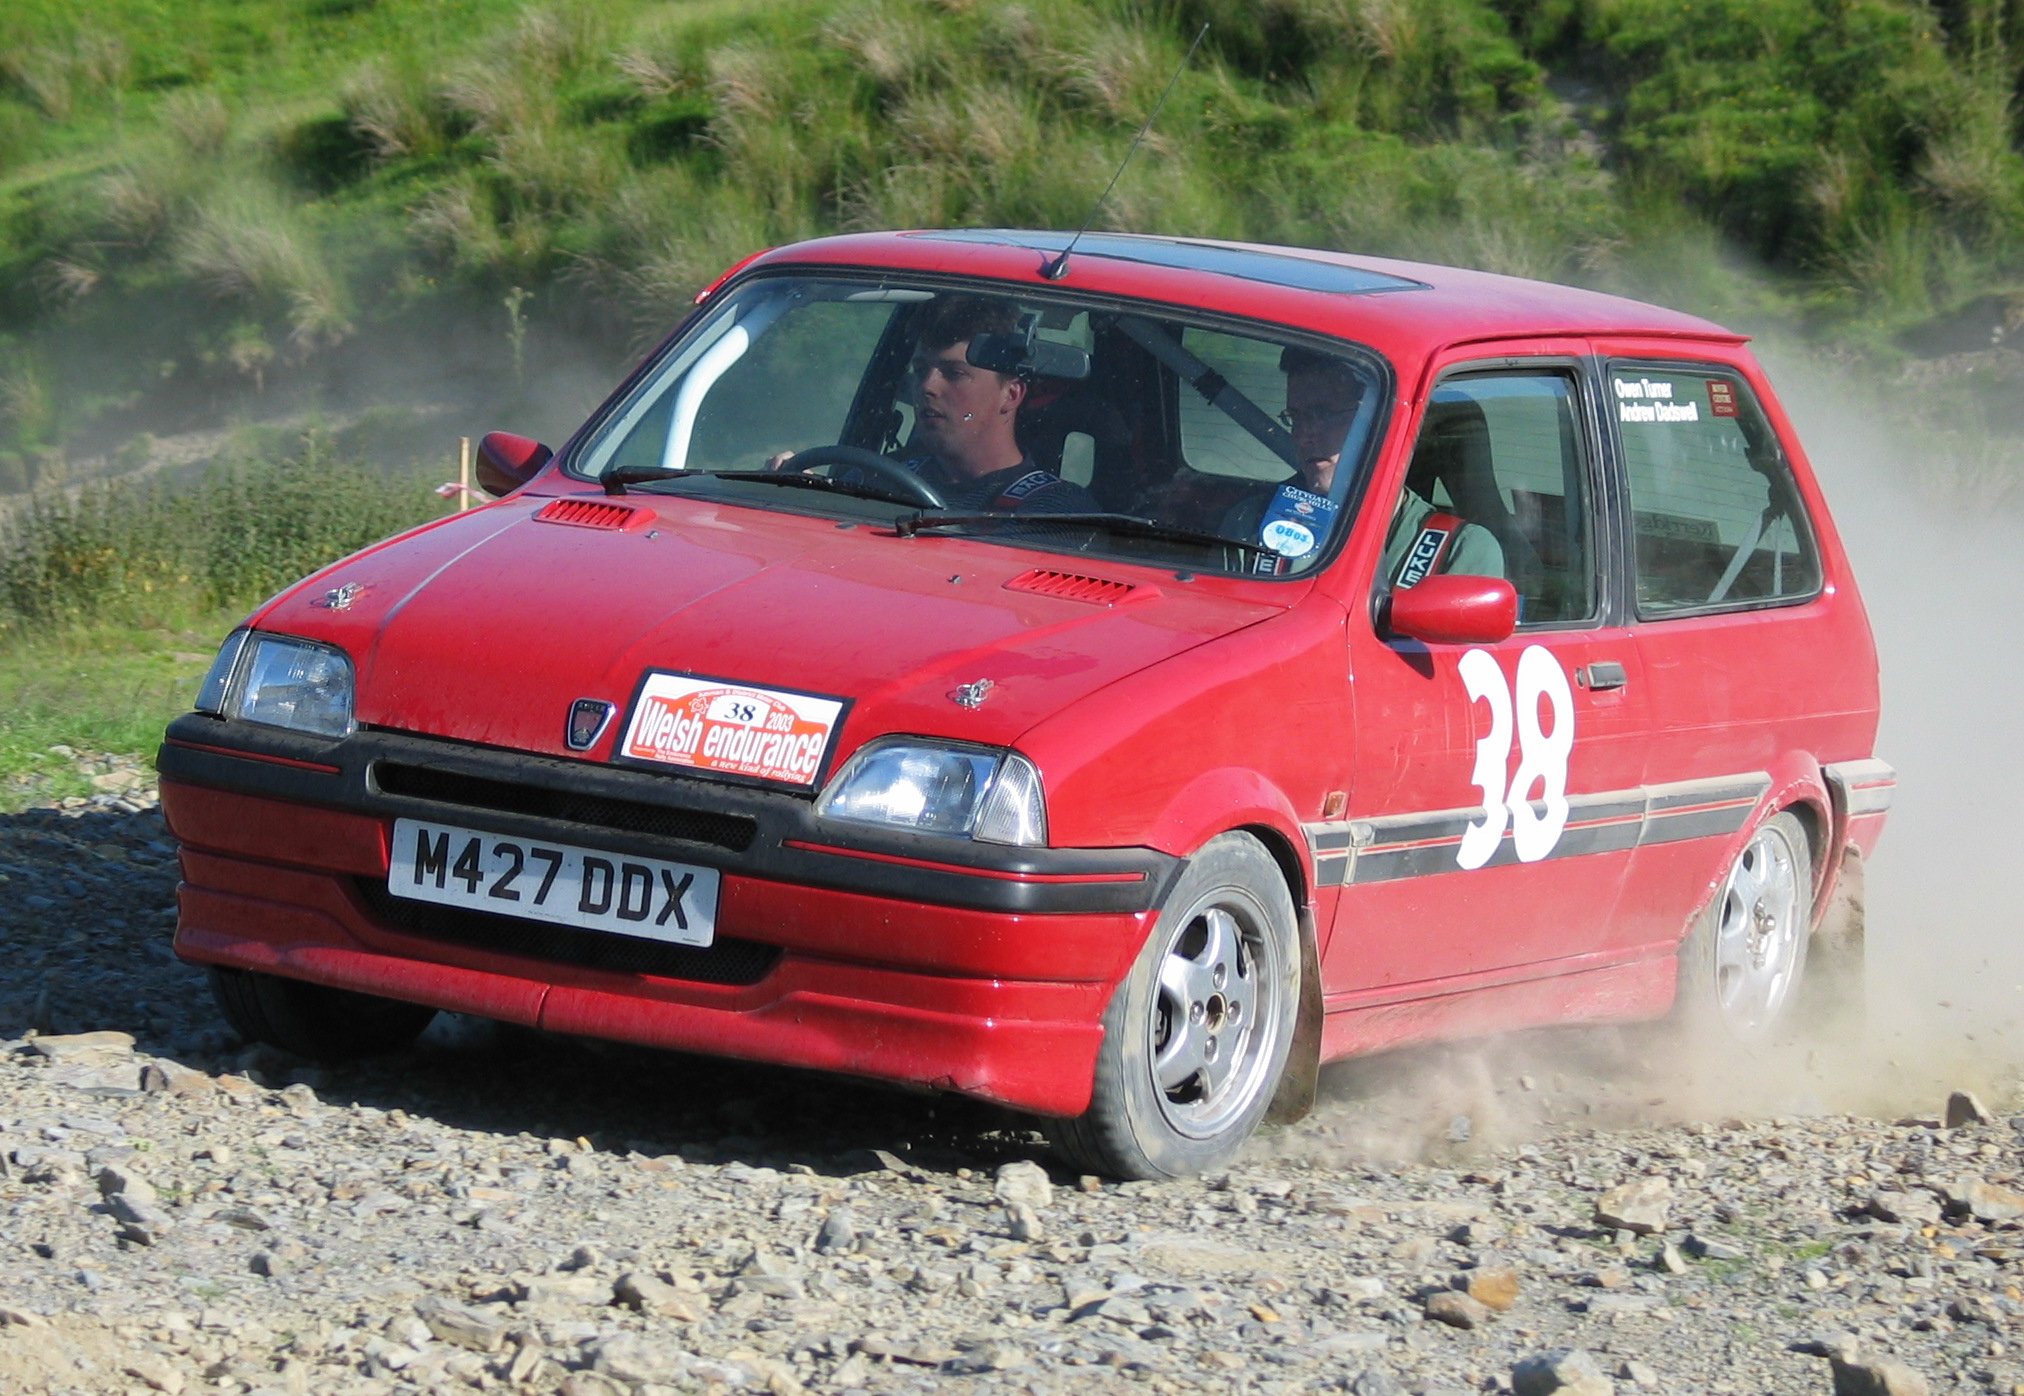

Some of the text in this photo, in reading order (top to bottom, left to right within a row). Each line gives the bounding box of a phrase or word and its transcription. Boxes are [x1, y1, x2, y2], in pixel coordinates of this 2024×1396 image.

[1615, 378, 1672, 398] Owen Turner
[1620, 401, 1655, 422] Andrew
[1405, 534, 1437, 584] LUKE
[724, 702, 757, 723] 38
[766, 711, 795, 732] 2003
[636, 698, 823, 774] Welsh endurance
[1455, 644, 1575, 871] 38
[711, 759, 717, 767] a
[719, 761, 737, 771] new
[739, 759, 760, 774] kind
[760, 766, 772, 778] of
[414, 829, 695, 930] M427 DDX
